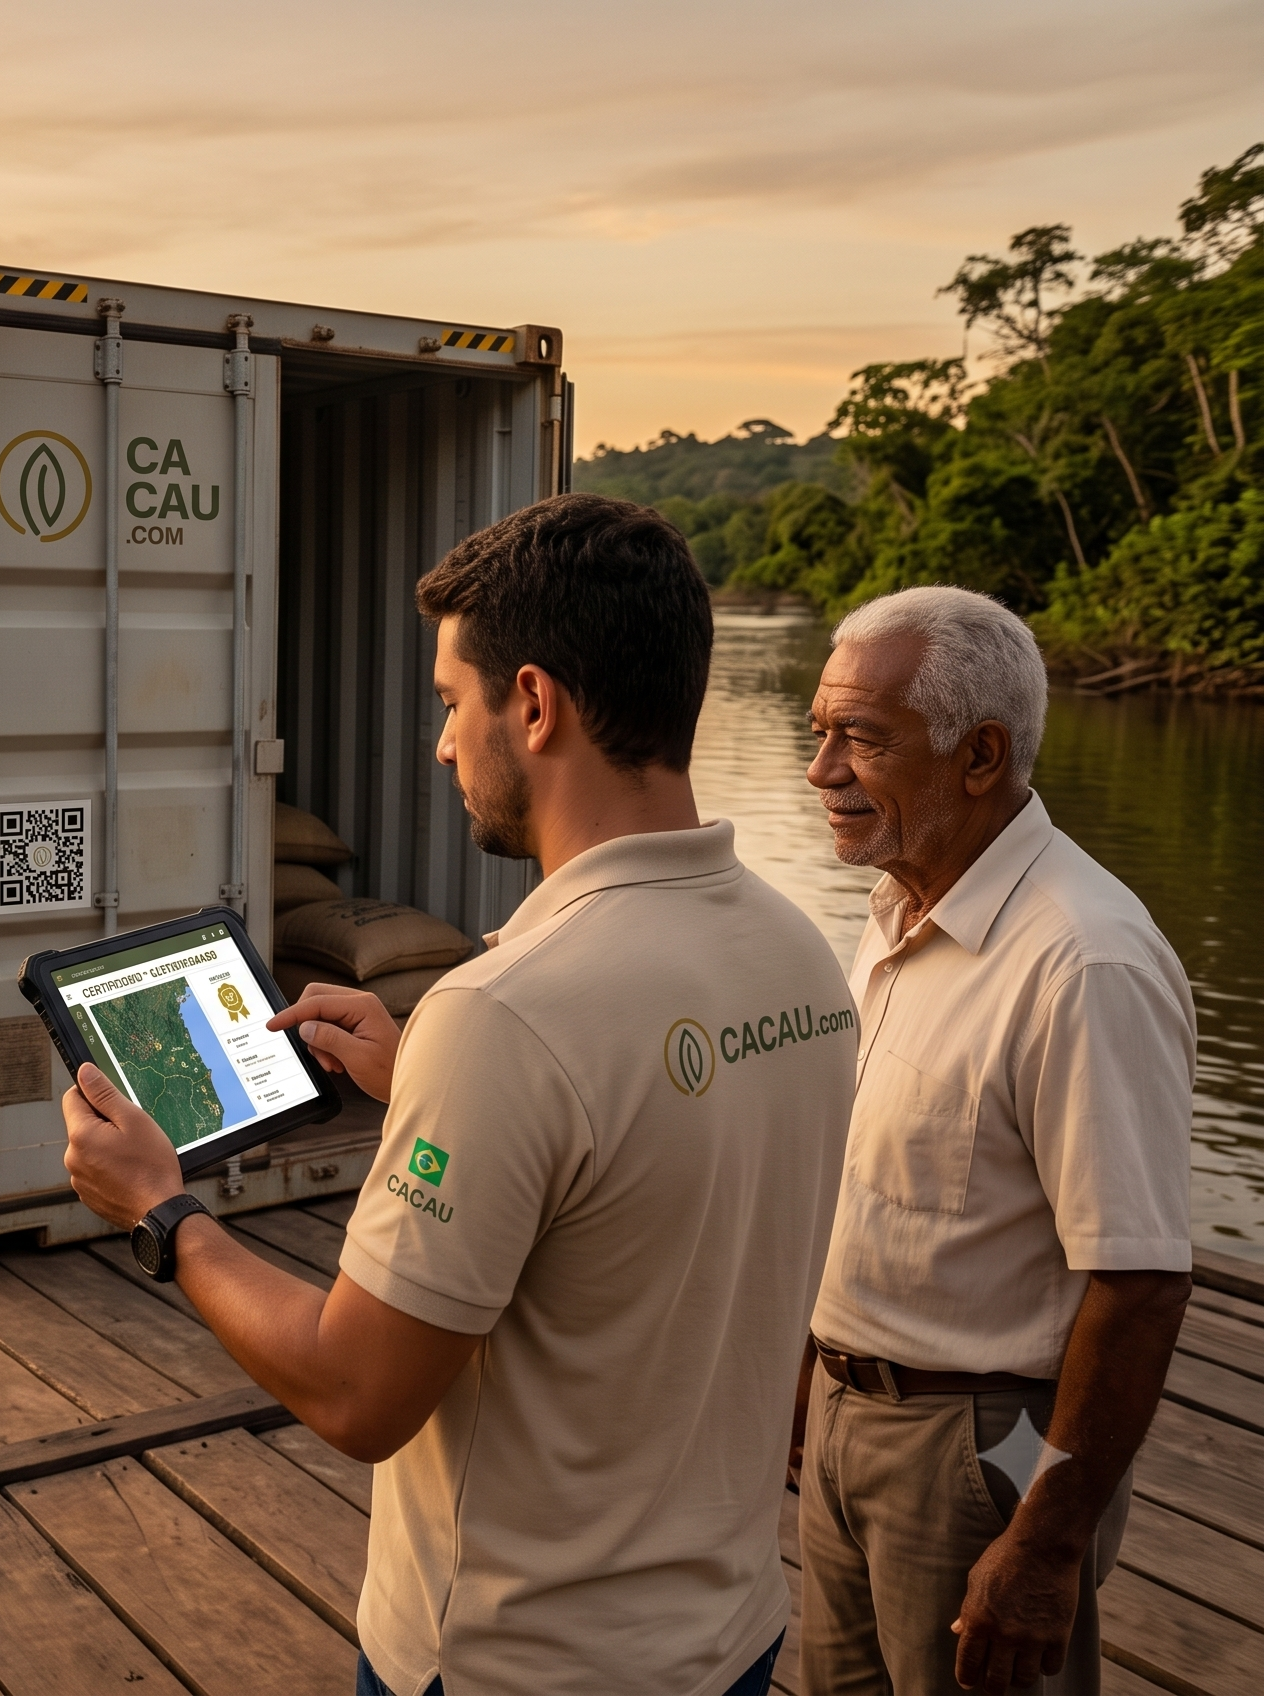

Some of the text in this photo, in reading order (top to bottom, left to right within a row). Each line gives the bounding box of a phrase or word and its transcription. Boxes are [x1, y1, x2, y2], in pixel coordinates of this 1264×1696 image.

[126, 436, 192, 476] CA
[125, 481, 220, 521] CAU
[126, 525, 184, 546] .COM
[719, 1004, 854, 1064] CACAU.com
[386, 1174, 455, 1224] CACAU
